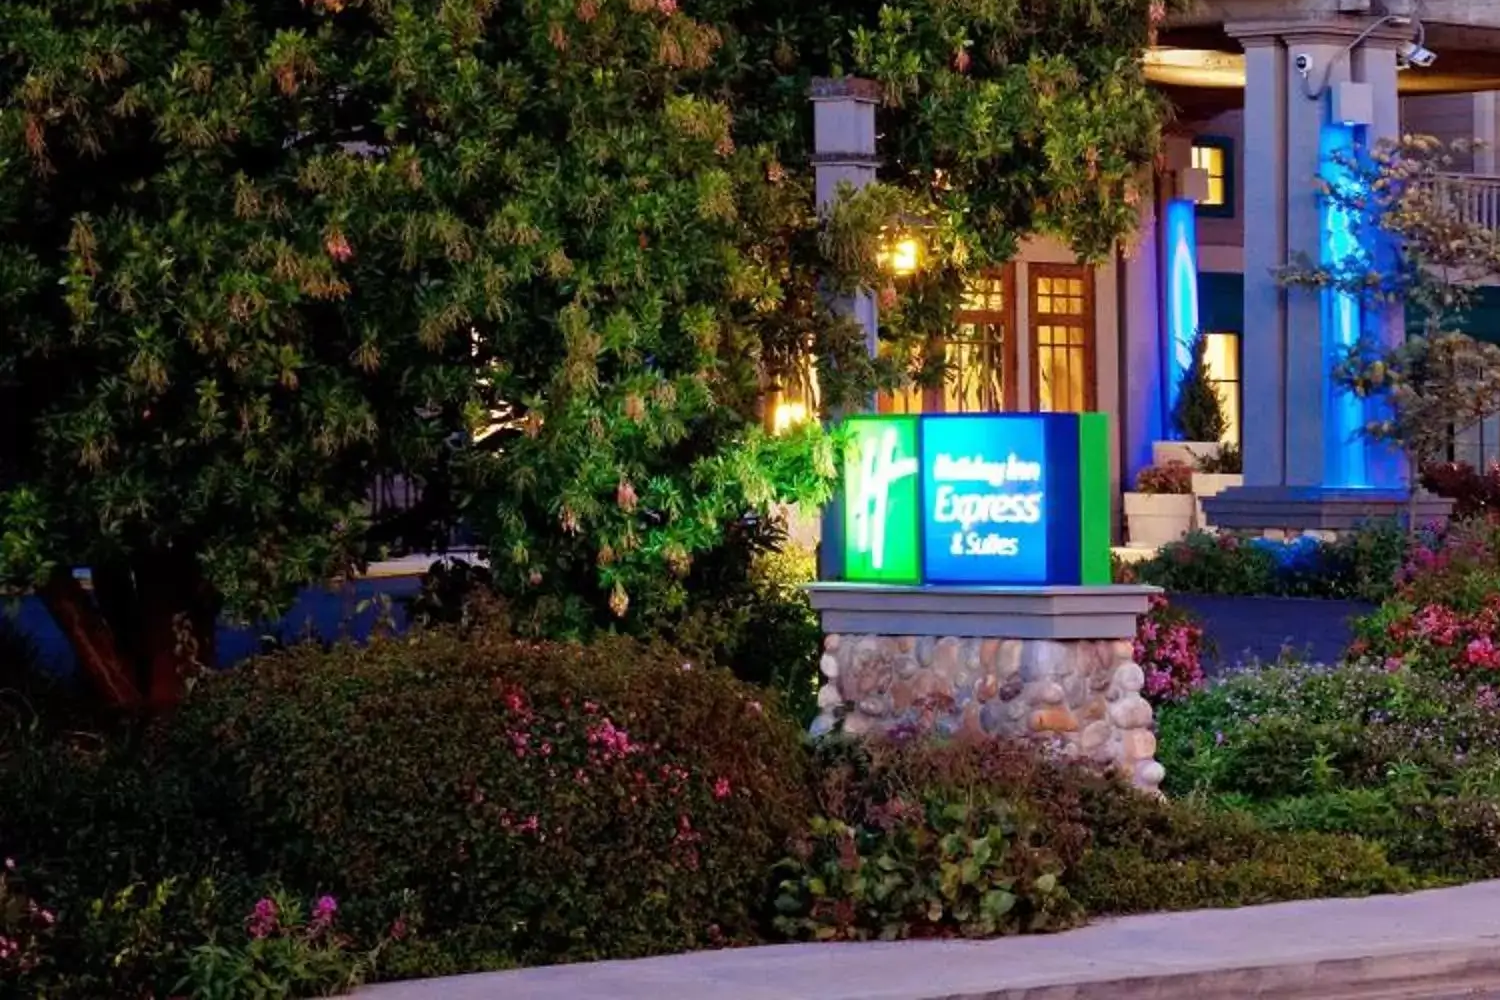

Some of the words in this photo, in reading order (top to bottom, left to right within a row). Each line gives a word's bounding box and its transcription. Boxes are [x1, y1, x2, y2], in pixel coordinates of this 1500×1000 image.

[1006, 452, 1041, 481] Inn
[934, 485, 1043, 531] Express
[966, 531, 1019, 556] Suites
